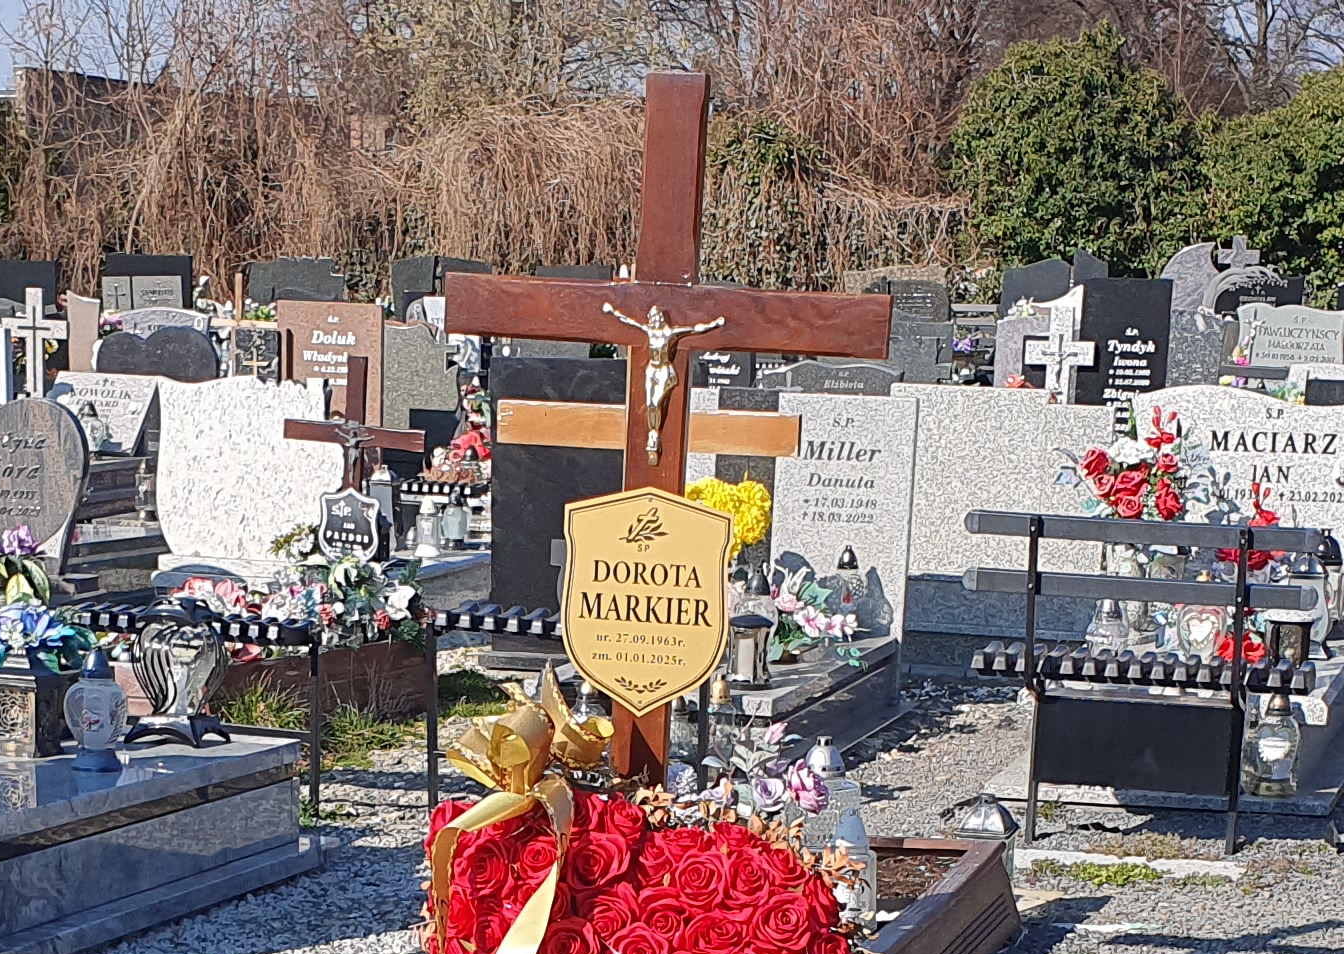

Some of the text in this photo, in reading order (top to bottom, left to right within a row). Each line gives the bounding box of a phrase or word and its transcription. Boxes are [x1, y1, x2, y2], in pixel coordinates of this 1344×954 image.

[311, 330, 356, 345] Doluk
[1107, 340, 1155, 354] Tyndyk
[1113, 356, 1147, 366] Iwona
[1210, 430, 1337, 454] MACIARZ
[802, 440, 882, 462] Miller
[807, 472, 876, 488] Danuta
[592, 560, 702, 588] DOROTA
[578, 592, 712, 627] MARKIER
[597, 633, 685, 647] ur. 27.09.1963r.
[592, 652, 685, 666] zm. 01.01.2025r.
